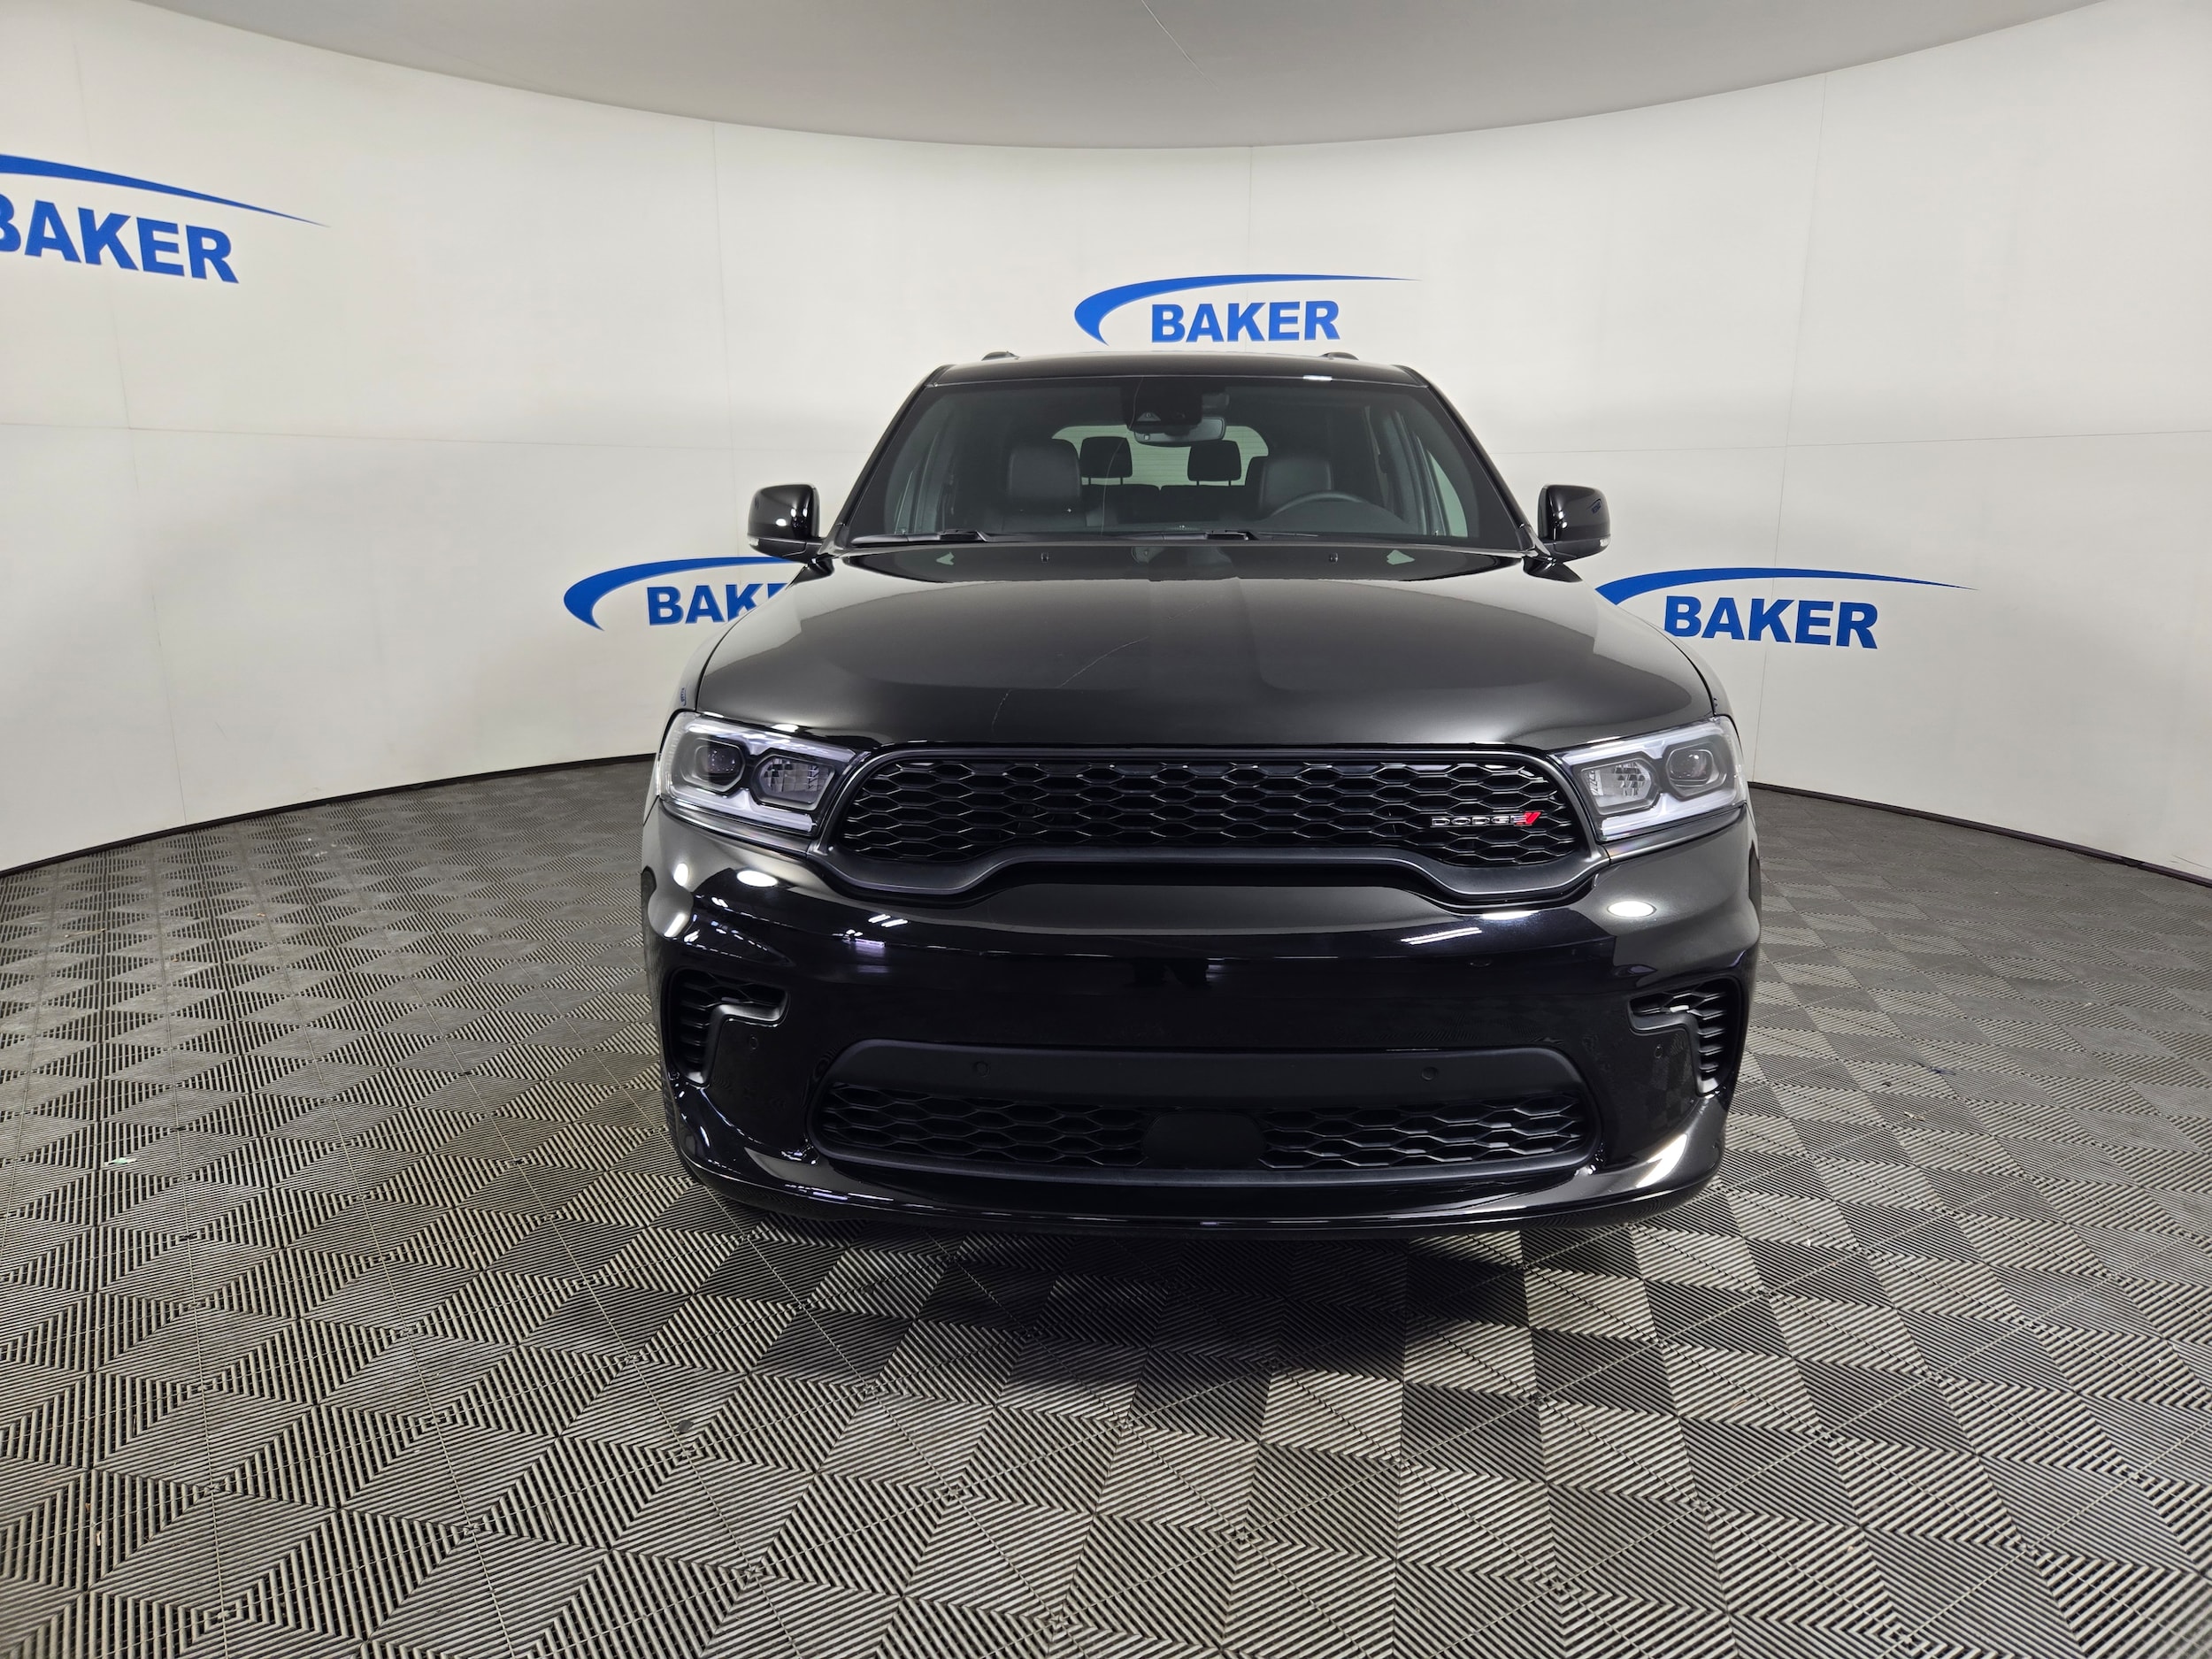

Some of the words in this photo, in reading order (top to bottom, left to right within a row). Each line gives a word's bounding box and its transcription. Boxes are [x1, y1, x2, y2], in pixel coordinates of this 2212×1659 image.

[1151, 300, 1340, 343] BAKER
[647, 582, 787, 626] BAK
[1663, 595, 1878, 649] BAKER
[1431, 814, 1528, 826] DODGE
